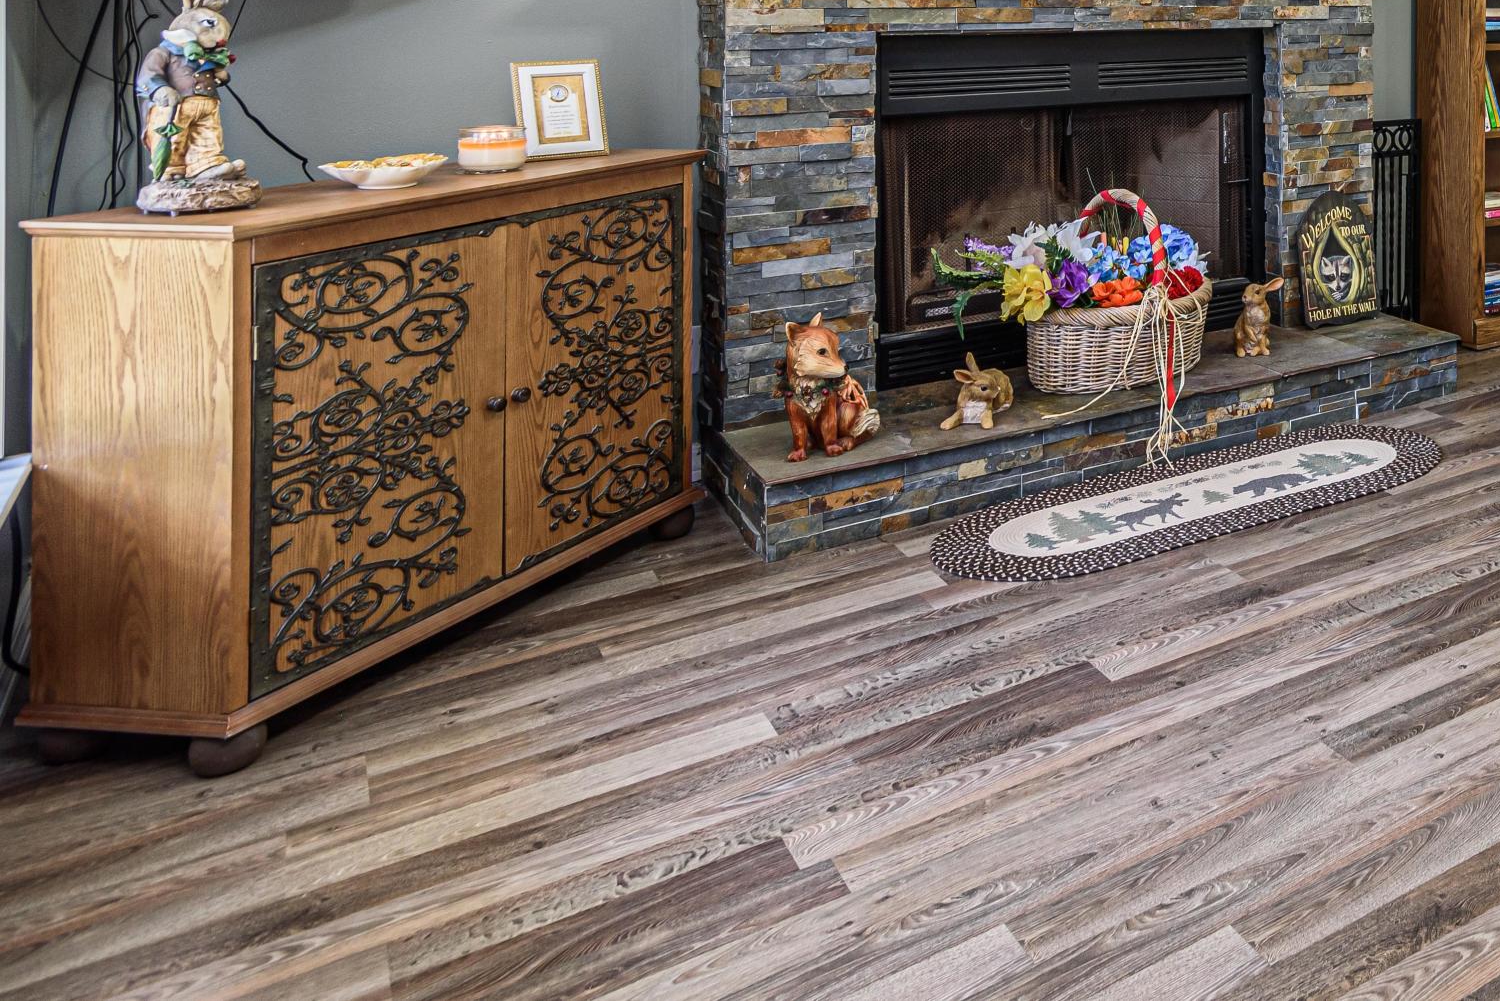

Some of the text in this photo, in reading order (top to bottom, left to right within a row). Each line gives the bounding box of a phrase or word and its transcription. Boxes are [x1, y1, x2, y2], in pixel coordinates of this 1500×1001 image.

[1302, 206, 1352, 249] WELCOME
[1340, 224, 1366, 237] TO OUR
[1309, 300, 1377, 322] HOLE IN THE WALL
